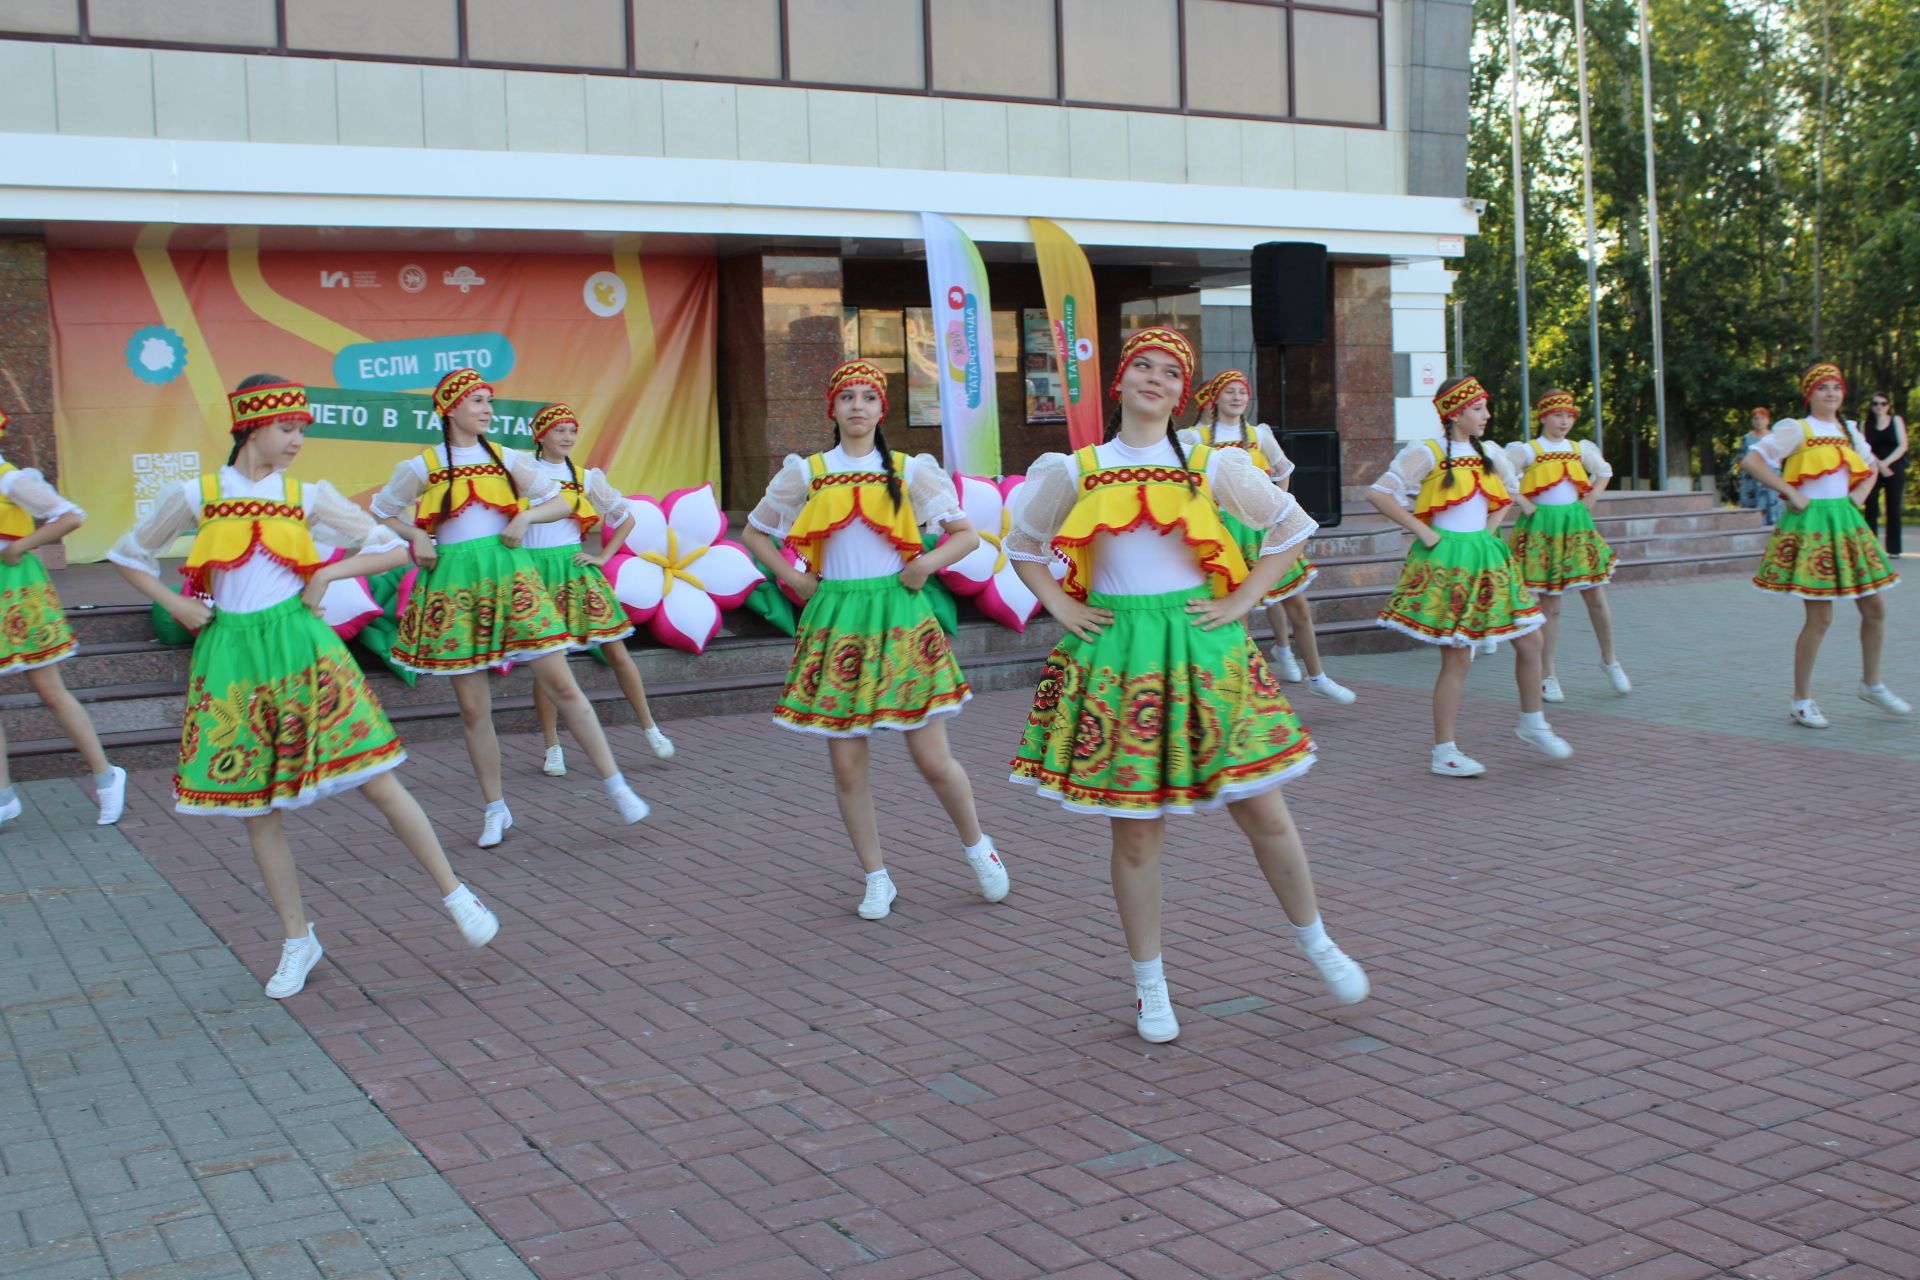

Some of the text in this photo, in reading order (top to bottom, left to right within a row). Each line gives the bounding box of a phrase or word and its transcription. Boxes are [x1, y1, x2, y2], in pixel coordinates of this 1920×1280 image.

[358, 348, 493, 379] ЕСЛИ ЛЕТО
[309, 403, 369, 427] ЛЕТО
[382, 407, 399, 428] В
